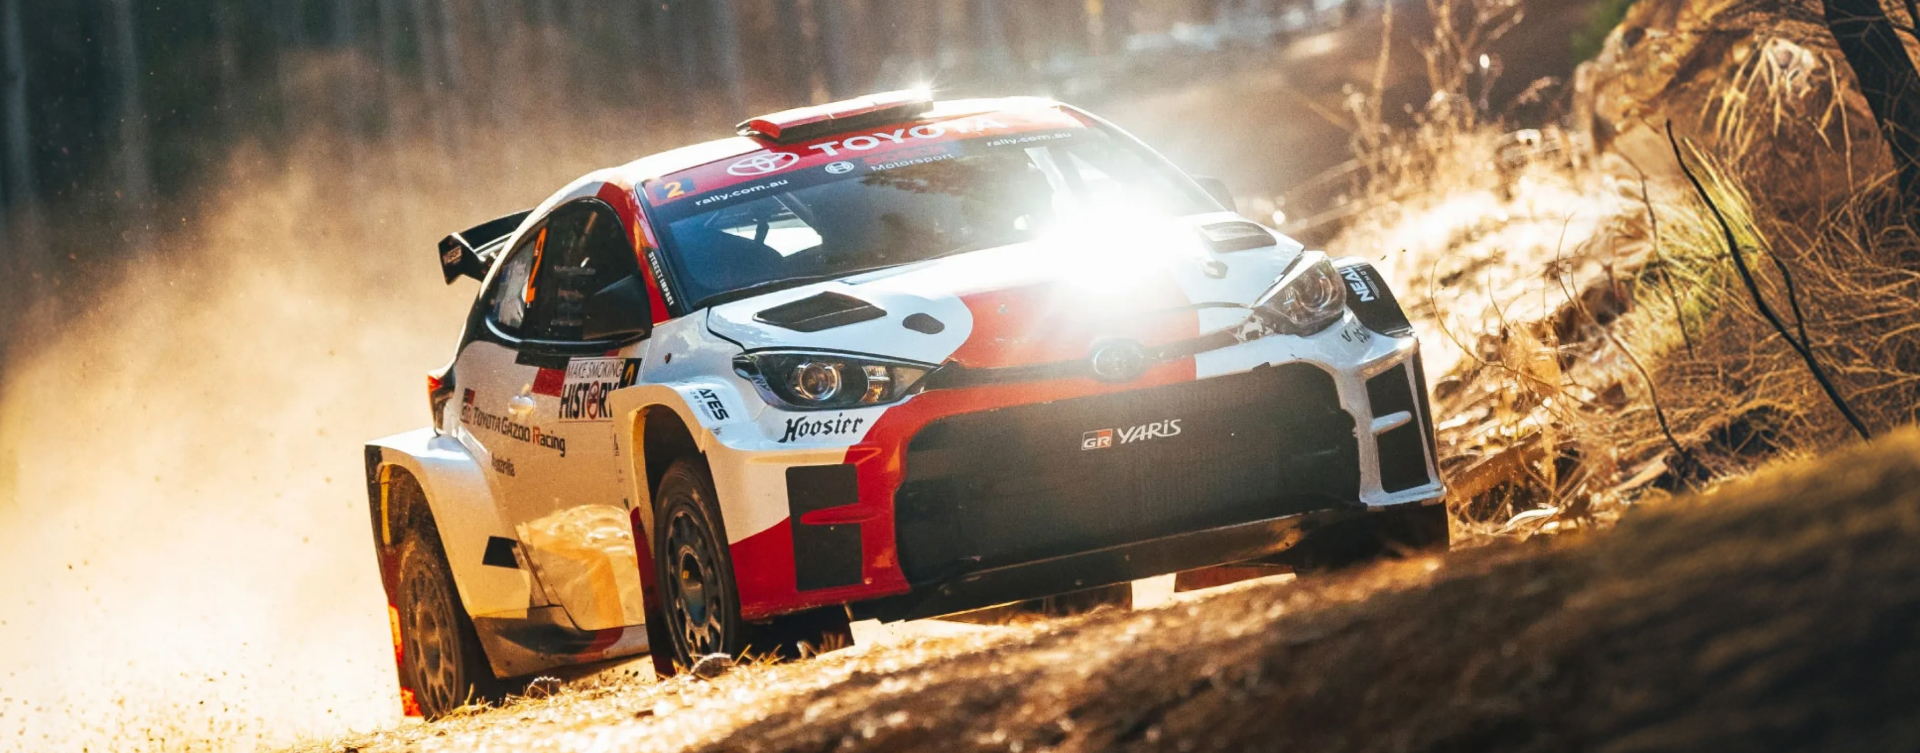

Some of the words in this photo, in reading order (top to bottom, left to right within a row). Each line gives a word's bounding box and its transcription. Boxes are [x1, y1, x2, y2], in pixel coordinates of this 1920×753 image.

[808, 116, 1009, 157] TOYOTA
[985, 131, 1072, 148] rally.com.au
[870, 153, 955, 172] Motorsport
[663, 181, 685, 199] 2
[695, 179, 789, 207] rally.com.au
[586, 361, 624, 378] SMOKING
[473, 407, 500, 432] TOYOTA
[501, 417, 531, 442] GAZOO
[532, 426, 566, 457] Racing
[777, 412, 864, 444] Hoosier
[1083, 436, 1111, 448] GR
